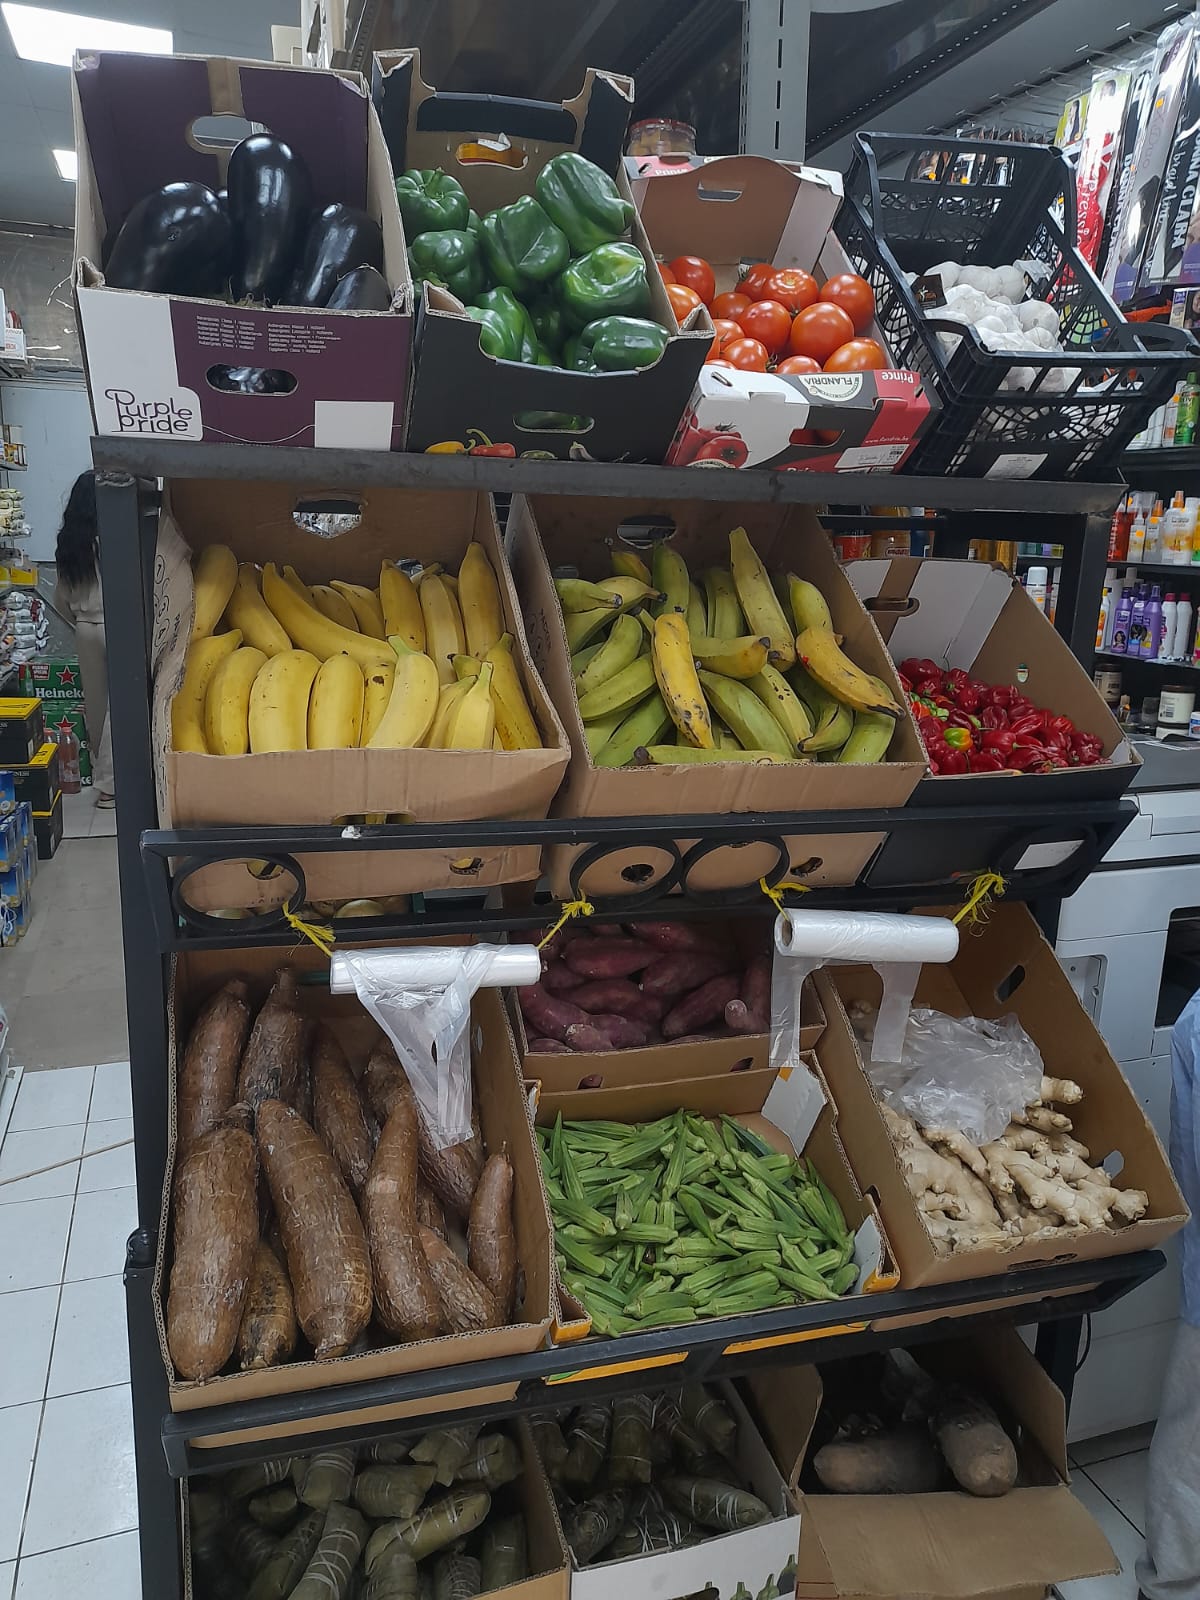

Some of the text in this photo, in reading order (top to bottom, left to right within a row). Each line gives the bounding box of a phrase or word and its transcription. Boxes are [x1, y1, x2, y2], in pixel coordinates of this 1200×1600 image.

[1171, 184, 1196, 249] CLARA
[804, 377, 853, 386] FLANDRIA
[882, 371, 914, 384] Prince
[105, 389, 193, 424] Purple
[35, 687, 85, 698] Heinek
